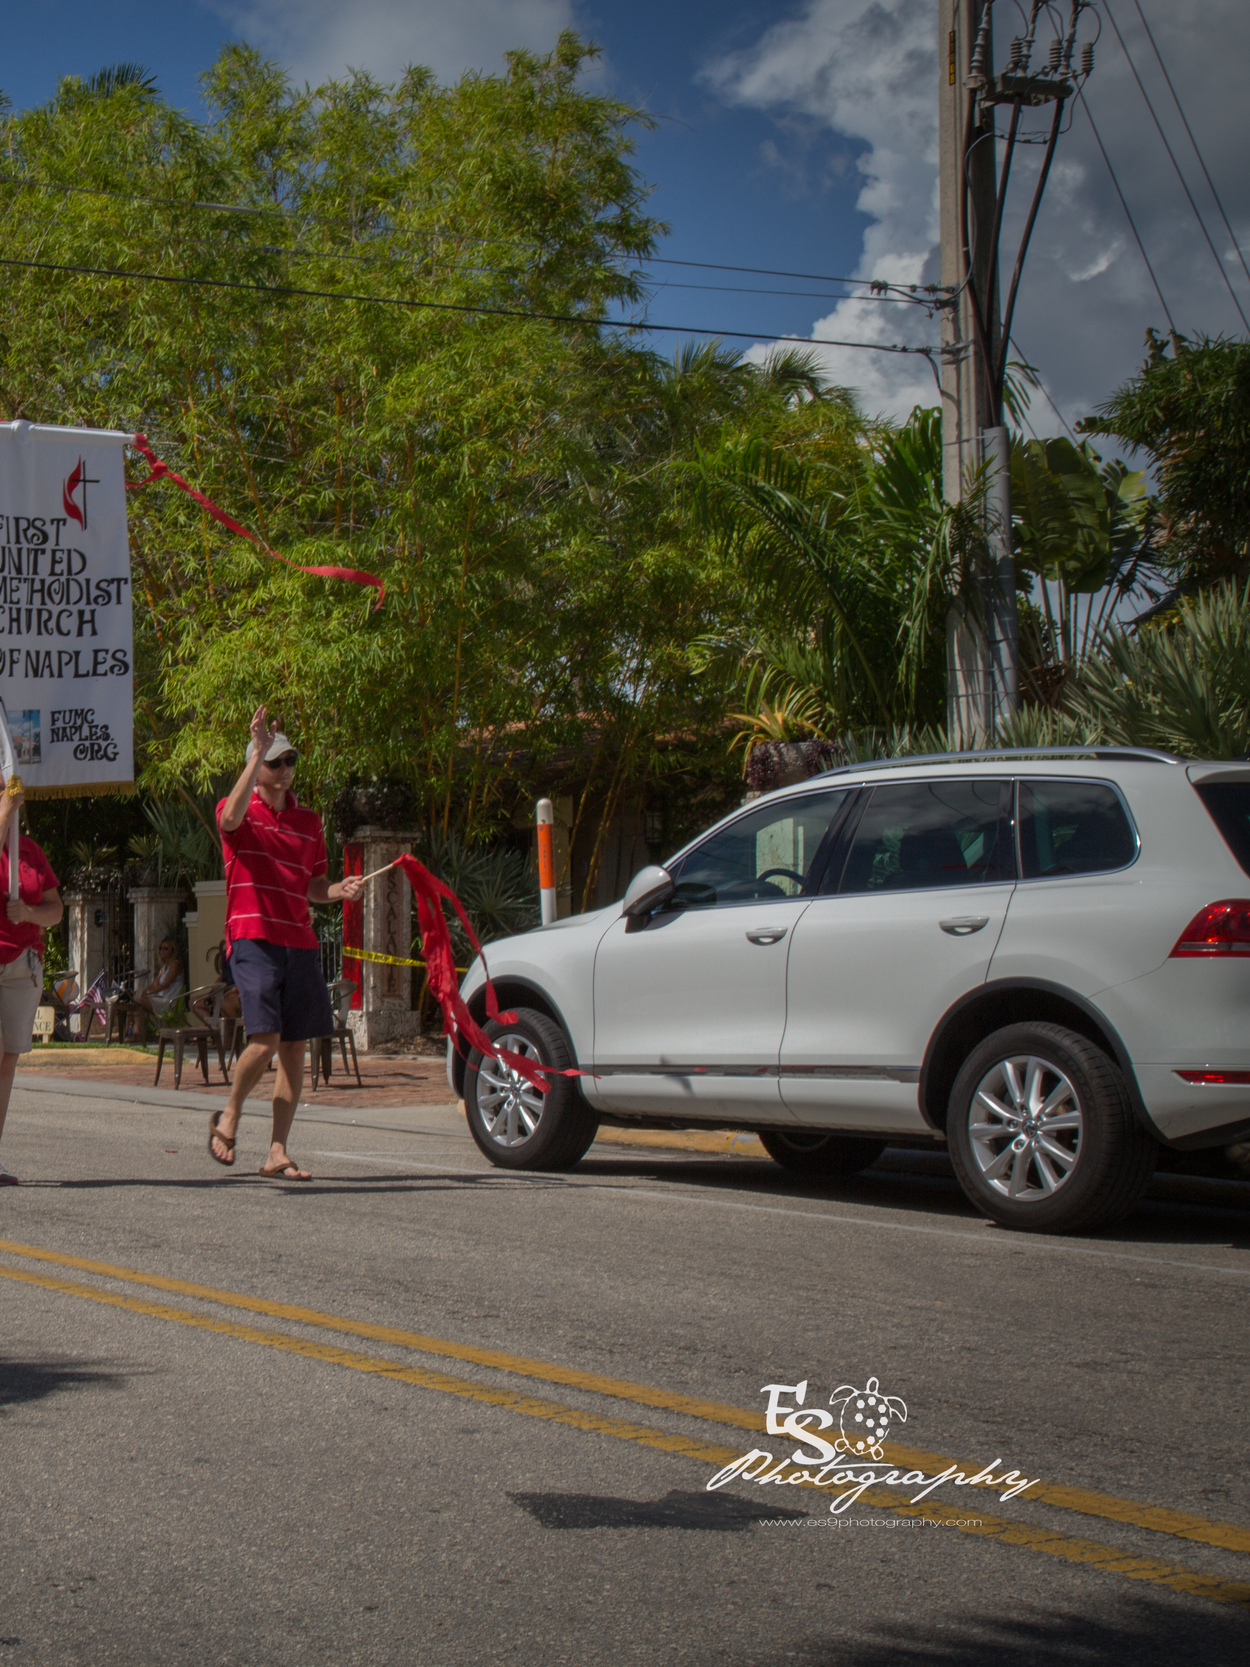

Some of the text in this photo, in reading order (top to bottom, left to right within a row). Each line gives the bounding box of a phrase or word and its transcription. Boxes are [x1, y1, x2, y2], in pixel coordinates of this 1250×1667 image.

[50, 708, 95, 727] FUMC
[49, 724, 115, 744] NAPLES.
[73, 742, 120, 762] ORG
